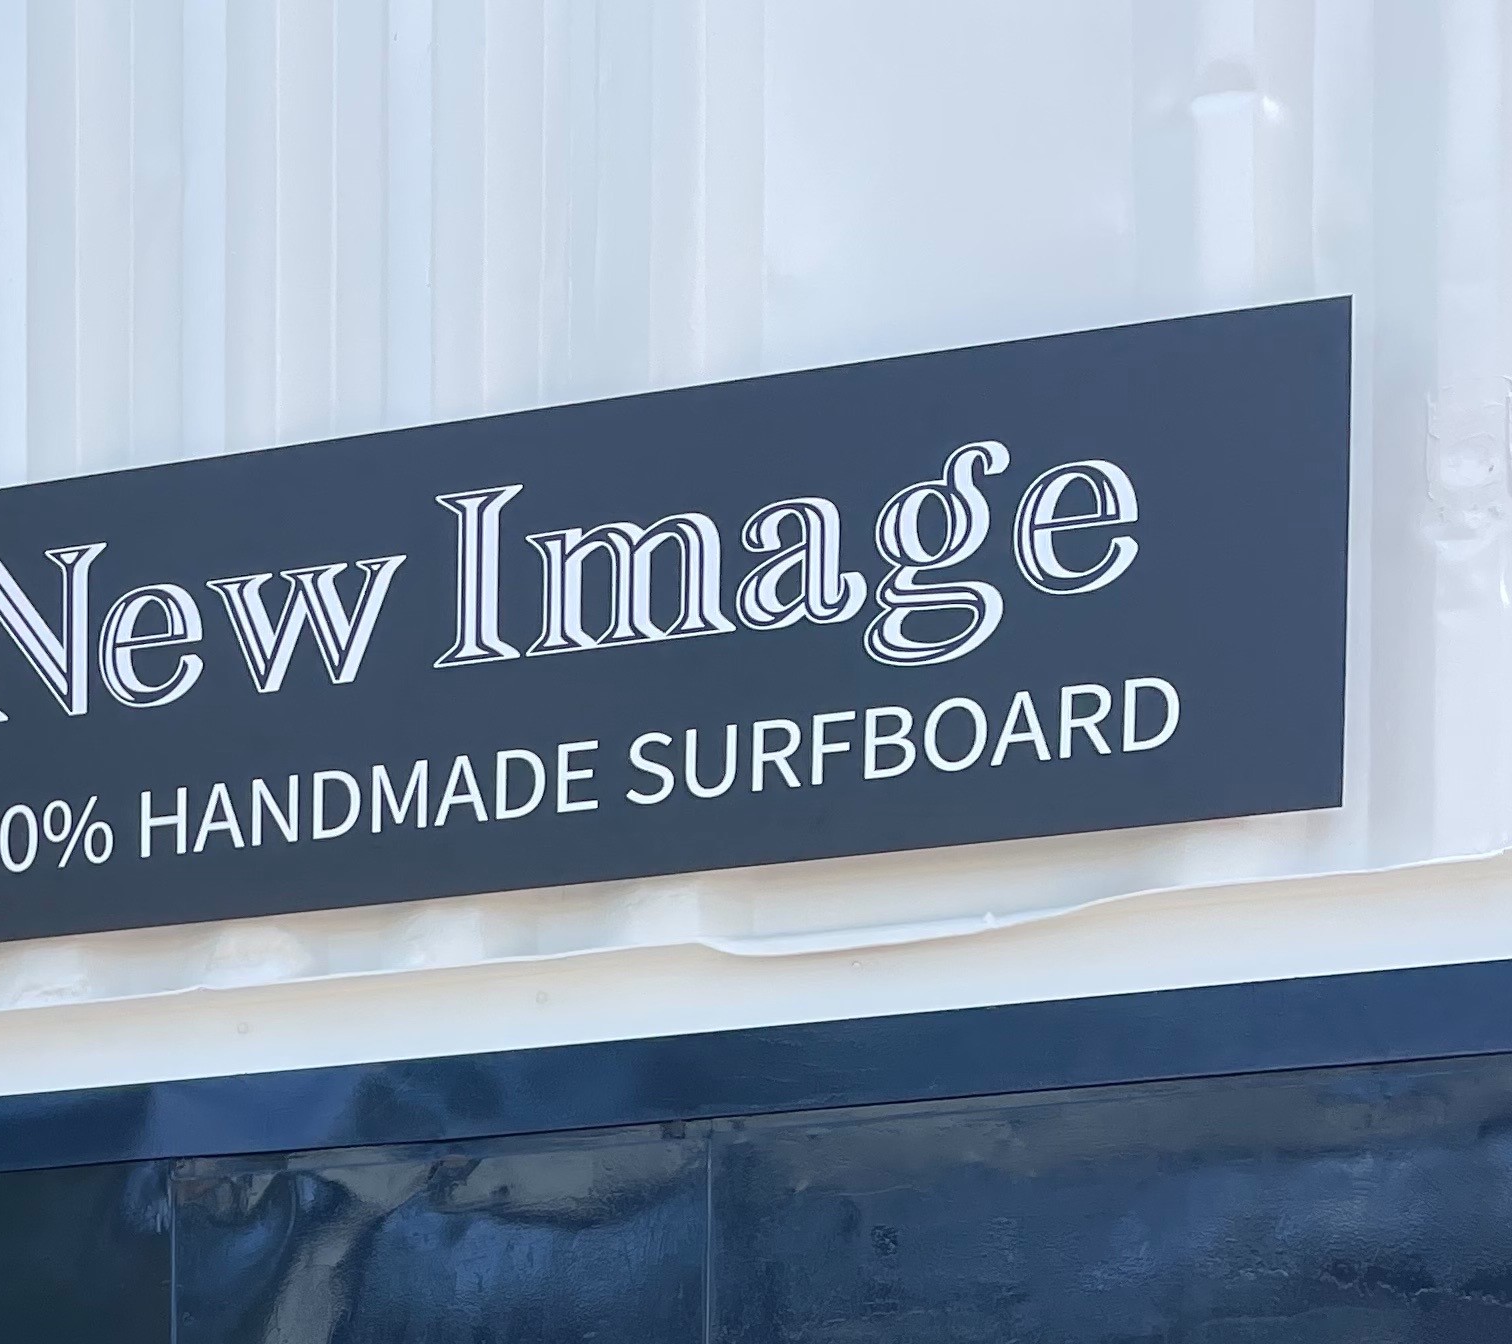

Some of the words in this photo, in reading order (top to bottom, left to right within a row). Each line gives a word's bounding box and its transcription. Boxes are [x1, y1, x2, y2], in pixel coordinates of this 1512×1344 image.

[433, 440, 1139, 669] Image
[140, 739, 599, 858] HANDMADE
[626, 677, 1180, 805] SURFBOARD
